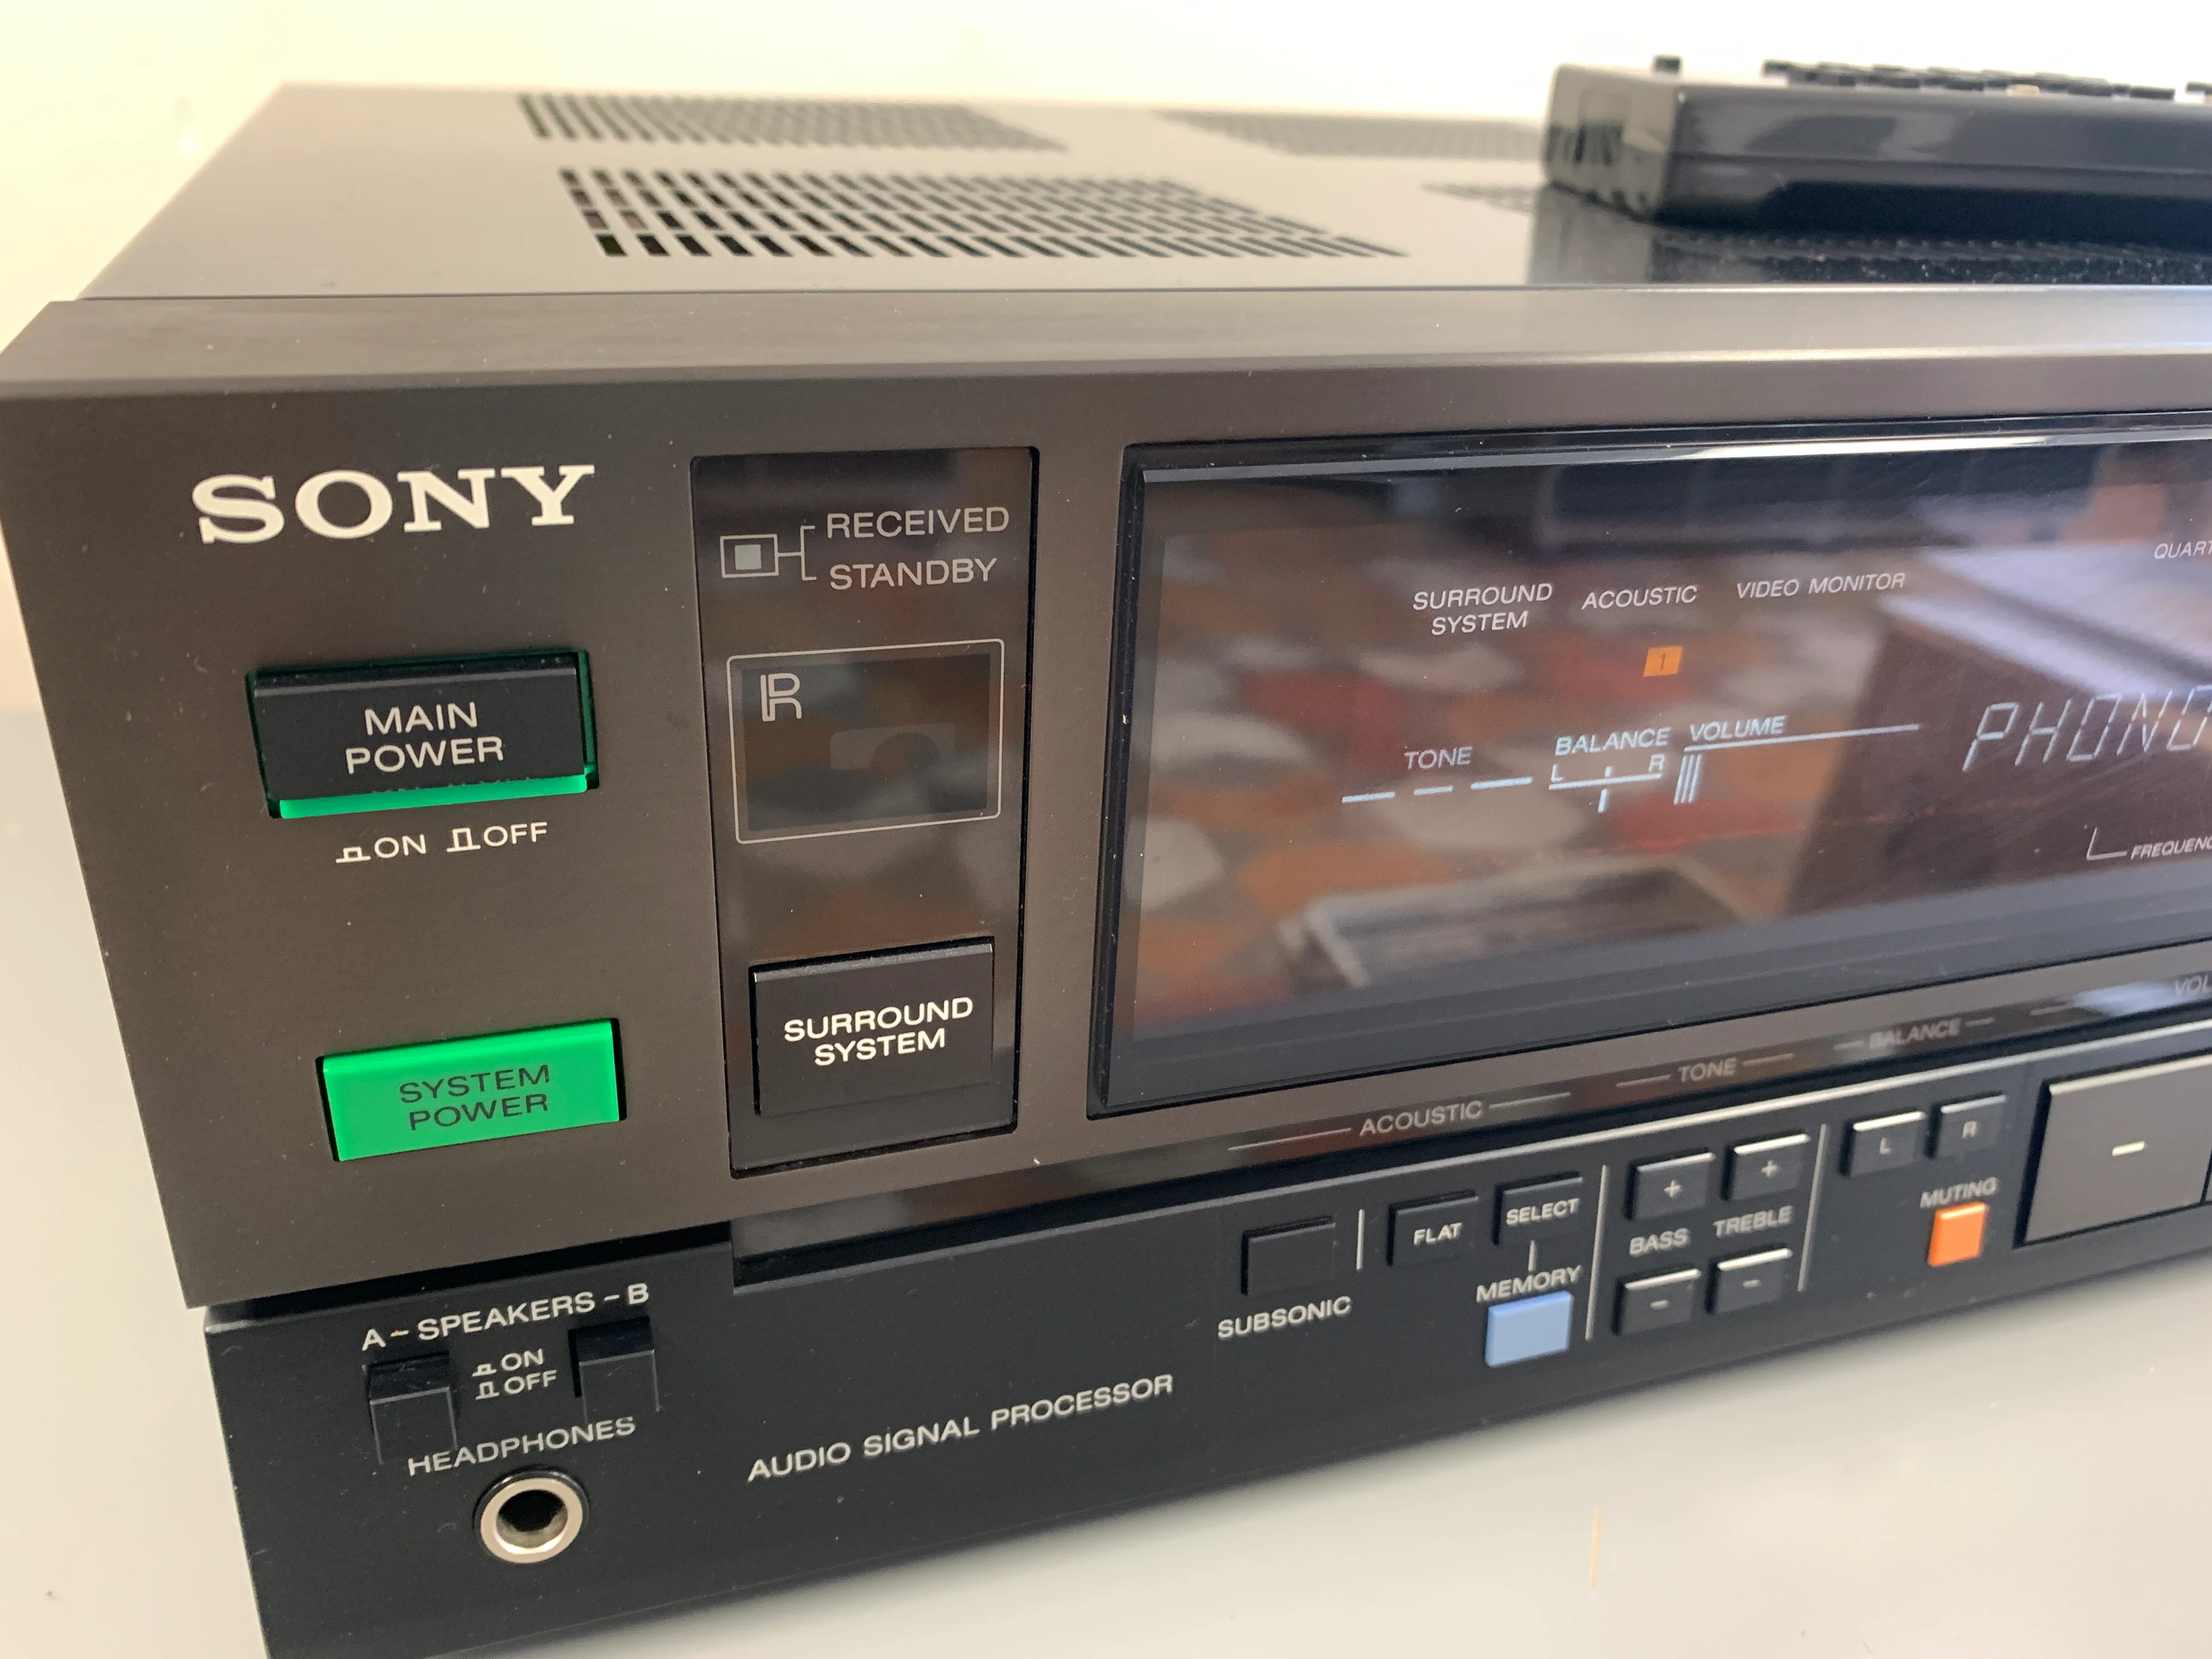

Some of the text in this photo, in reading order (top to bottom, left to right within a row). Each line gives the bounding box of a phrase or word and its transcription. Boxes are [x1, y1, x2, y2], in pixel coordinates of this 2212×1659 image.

[191, 465, 595, 544] SONY
[827, 506, 1009, 538] RECEIVED
[830, 557, 997, 590] STANDBY
[1737, 572, 1906, 600] VIDEO MONITOR
[1413, 583, 1553, 611] SURROUND
[1582, 585, 1697, 610] ACOUSTIC
[1431, 611, 1528, 636] SYSTEM
[364, 702, 477, 736] MAIN
[1690, 715, 1787, 741] VOLUME
[1962, 684, 2212, 772] PHONO
[345, 736, 504, 774] POWER
[1555, 726, 1672, 756] BALANCE
[1404, 747, 1472, 769] TONE
[1649, 753, 1665, 772] R
[374, 822, 548, 860] ON OFF
[784, 997, 973, 1042] SURROUND
[1869, 1018, 1961, 1049] BALANCE
[814, 1028, 945, 1066] SYSTEM
[399, 1065, 550, 1103] SYSTEM
[1678, 1058, 1737, 1082] TONE
[409, 1093, 548, 1131] POWER
[1359, 1100, 1483, 1137] ACOUSTIC
[1880, 1137, 1891, 1155] L
[1920, 1176, 1999, 1208] MUTING
[1506, 1198, 1579, 1226] SELECT
[1713, 1205, 1794, 1237] TREBLE
[1413, 1222, 1463, 1245] FLAT
[1629, 1228, 1690, 1256] BASS
[1476, 1265, 1582, 1302] MEMORY
[362, 1328, 386, 1351] A
[417, 1291, 595, 1340] SPEAKERS
[628, 1283, 649, 1305] B
[1217, 1296, 1352, 1339] SUBSONIC
[501, 1348, 544, 1371] ON
[504, 1370, 557, 1395] OFF
[747, 1374, 1173, 1482] AUDIO SIGNAL PROCESSOR
[408, 1416, 636, 1476] HEADPHONES
